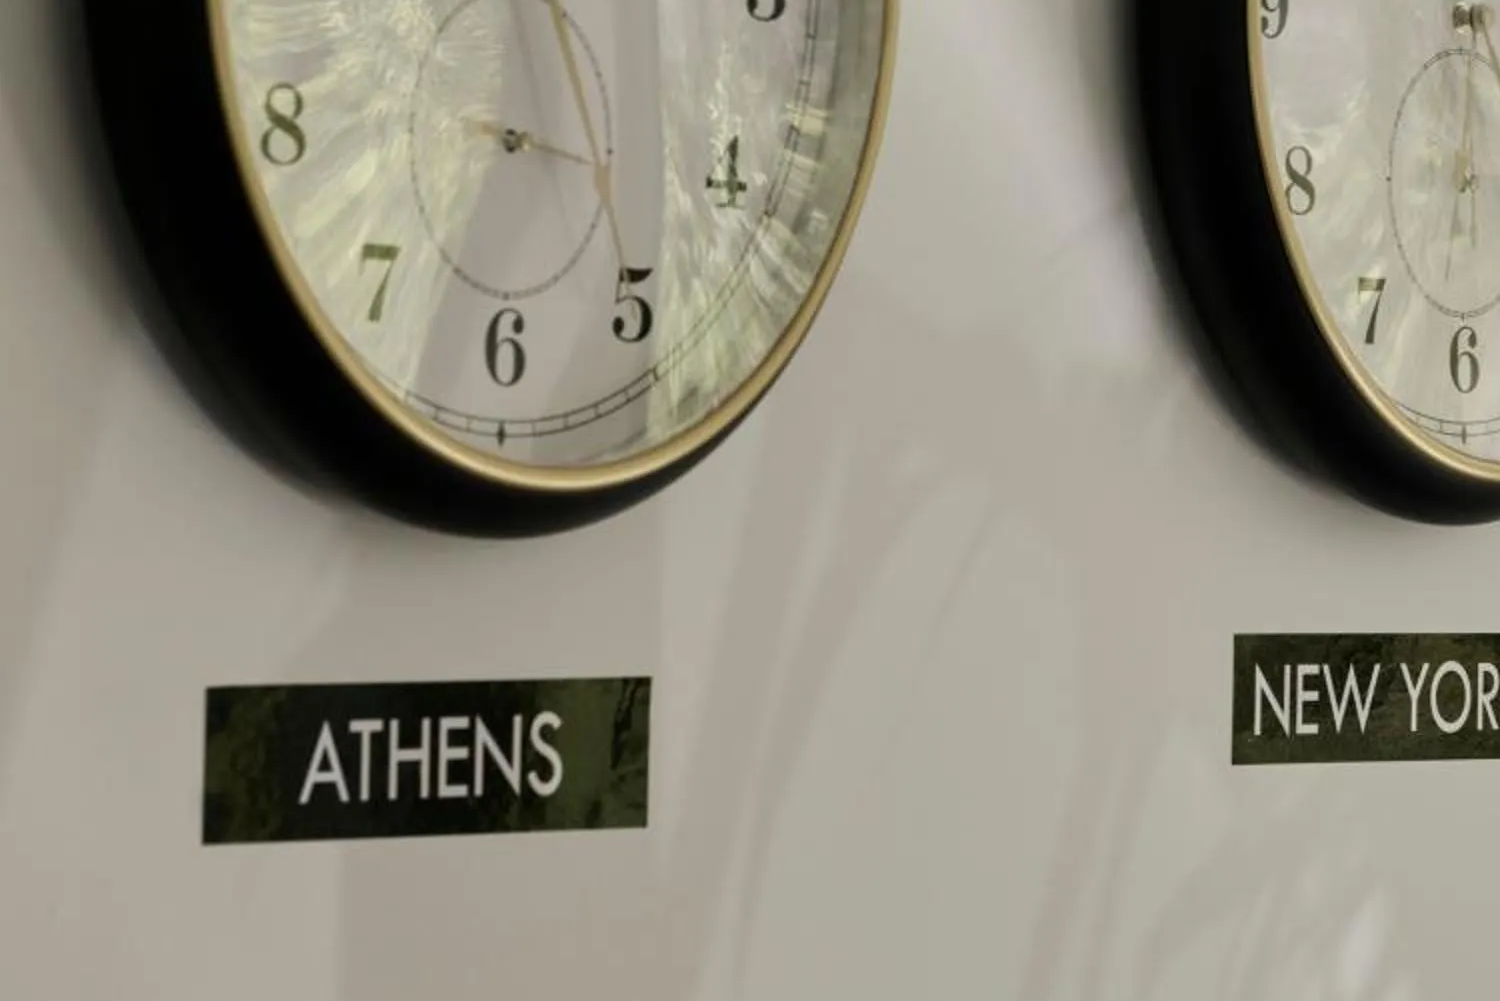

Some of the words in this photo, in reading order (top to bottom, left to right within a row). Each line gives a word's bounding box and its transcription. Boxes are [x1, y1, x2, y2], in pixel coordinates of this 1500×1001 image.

[261, 83, 305, 166] 8
[706, 136, 747, 208] 4
[1285, 146, 1315, 215] 8
[361, 244, 400, 322] 7
[612, 268, 653, 342] 5
[1358, 277, 1386, 344] 7
[484, 308, 525, 386] 6
[1449, 326, 1479, 393] 6
[1254, 662, 1381, 738] NEW
[298, 710, 563, 805] ATHENS
